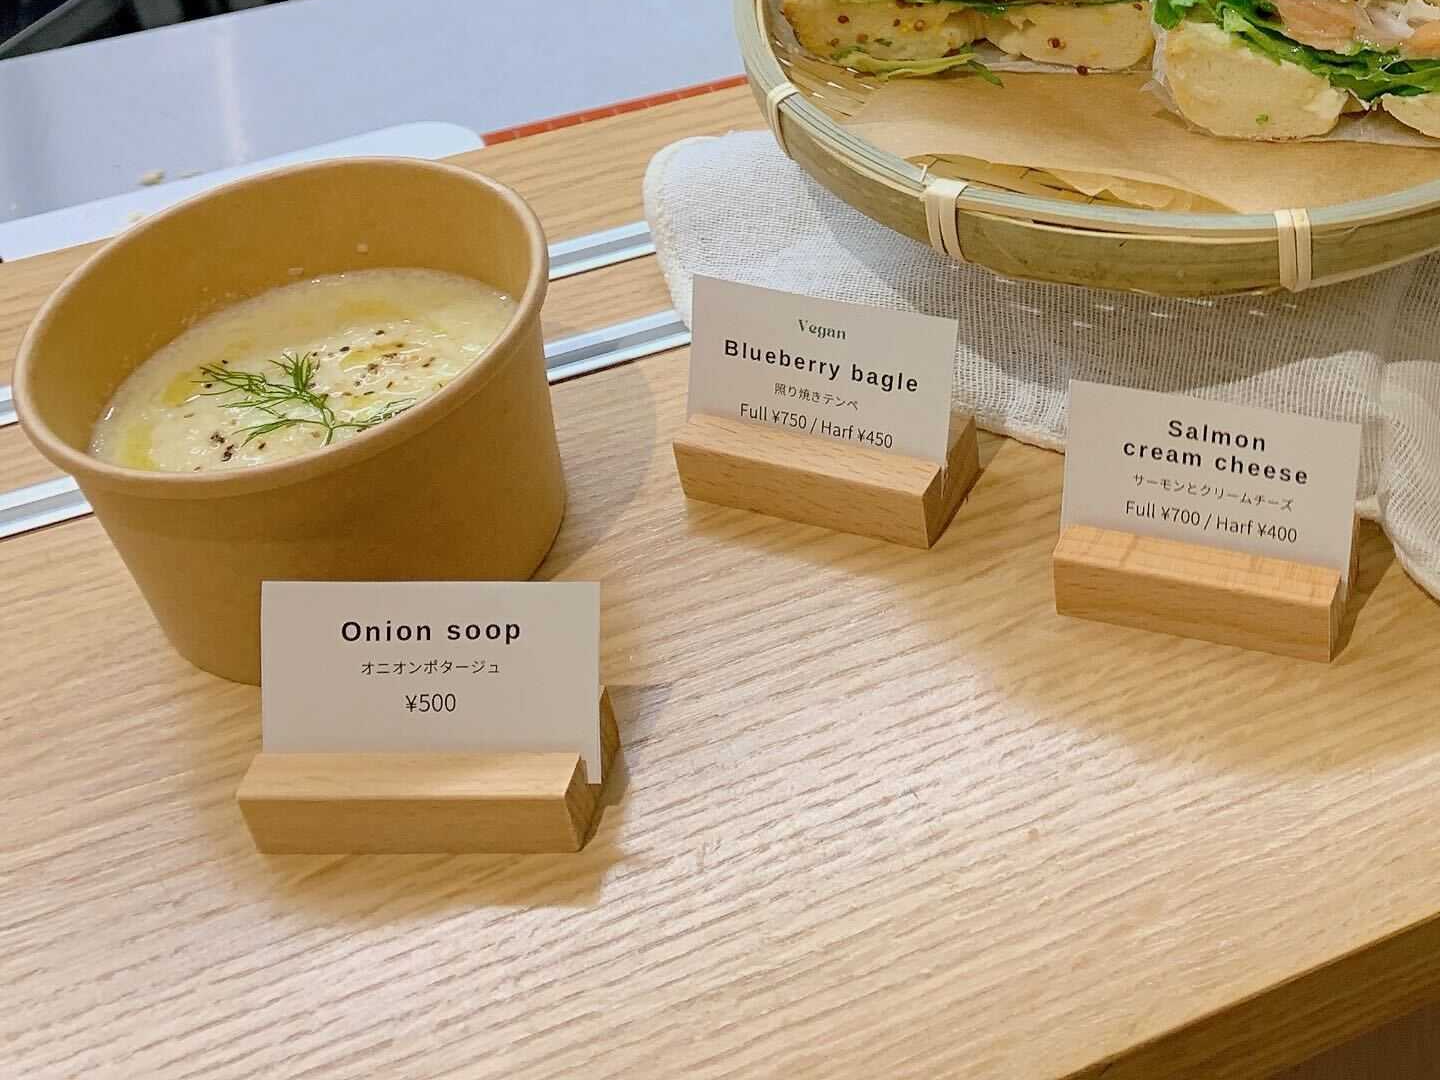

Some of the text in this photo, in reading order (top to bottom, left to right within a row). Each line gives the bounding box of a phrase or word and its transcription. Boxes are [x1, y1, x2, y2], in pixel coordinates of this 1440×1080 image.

[798, 319, 847, 340] Vegan
[724, 339, 919, 393] Blueberry bagle
[773, 381, 860, 411] 照り焼きテンペ
[740, 403, 893, 449] Full ¥750 / Harf ¥450
[1168, 419, 1266, 452] Salmon
[1123, 441, 1309, 485] cream cheese
[1133, 472, 1294, 512] サーモンとクリームチーズ
[1125, 500, 1298, 544] Full ¥700 / Harf ¥400
[341, 620, 521, 645] Onion soop
[361, 659, 501, 675] オニオンポタージュ
[405, 693, 457, 713] ¥500
